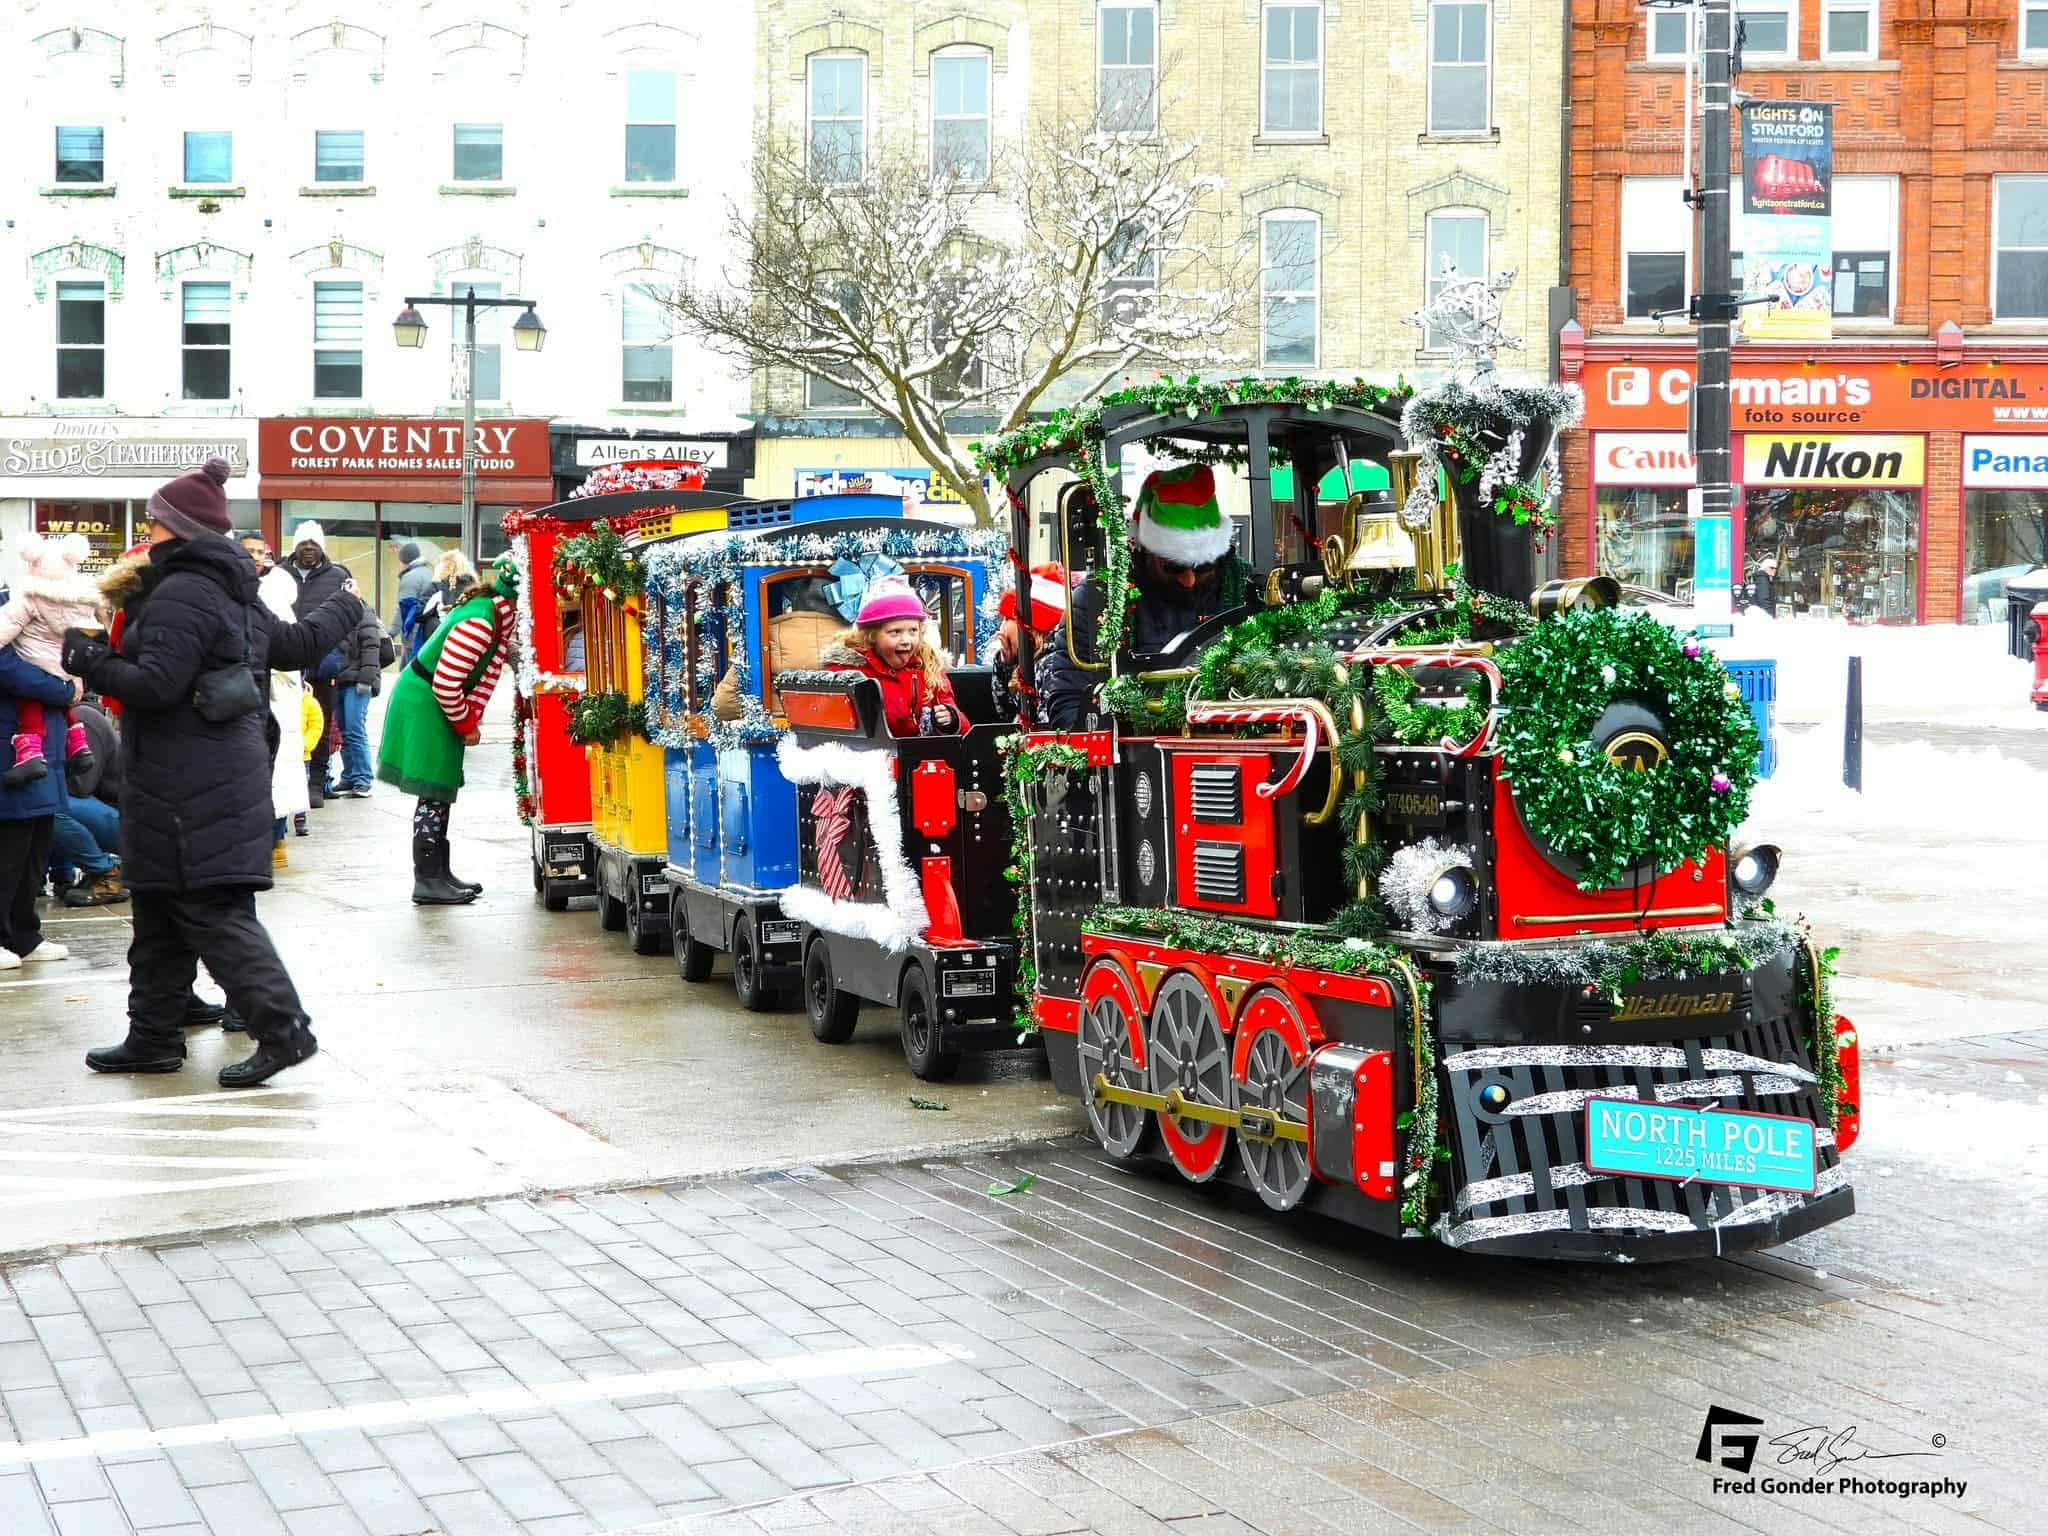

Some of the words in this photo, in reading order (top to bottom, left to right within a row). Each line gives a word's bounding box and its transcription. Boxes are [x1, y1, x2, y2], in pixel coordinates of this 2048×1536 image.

[1750, 107, 1796, 121] LIGHTS
[1800, 107, 1824, 122] ON
[1751, 123, 1824, 137] STRATFORD
[1659, 368, 1871, 405] Crman's
[1910, 378, 2026, 399] DIGITAL
[1744, 408, 1784, 423] foto
[1791, 411, 1862, 423] source
[289, 425, 518, 454] COVENTRY
[291, 457, 339, 469] FOREST
[342, 457, 376, 469] PARK
[378, 457, 423, 469] HOMES
[425, 457, 462, 469] SALES
[473, 458, 515, 470] TUDIO
[591, 444, 656, 460] Allen's
[662, 446, 715, 464] Alley
[1608, 446, 1697, 469] Cano
[1764, 441, 1903, 479] Nikon
[47, 520, 74, 532] WE
[76, 521, 111, 533] DO:
[1600, 1108, 1707, 1148] NORTH
[1722, 1120, 1804, 1159] POLE
[1655, 1147, 1697, 1168] 1225
[1702, 1151, 1757, 1173] MILES
